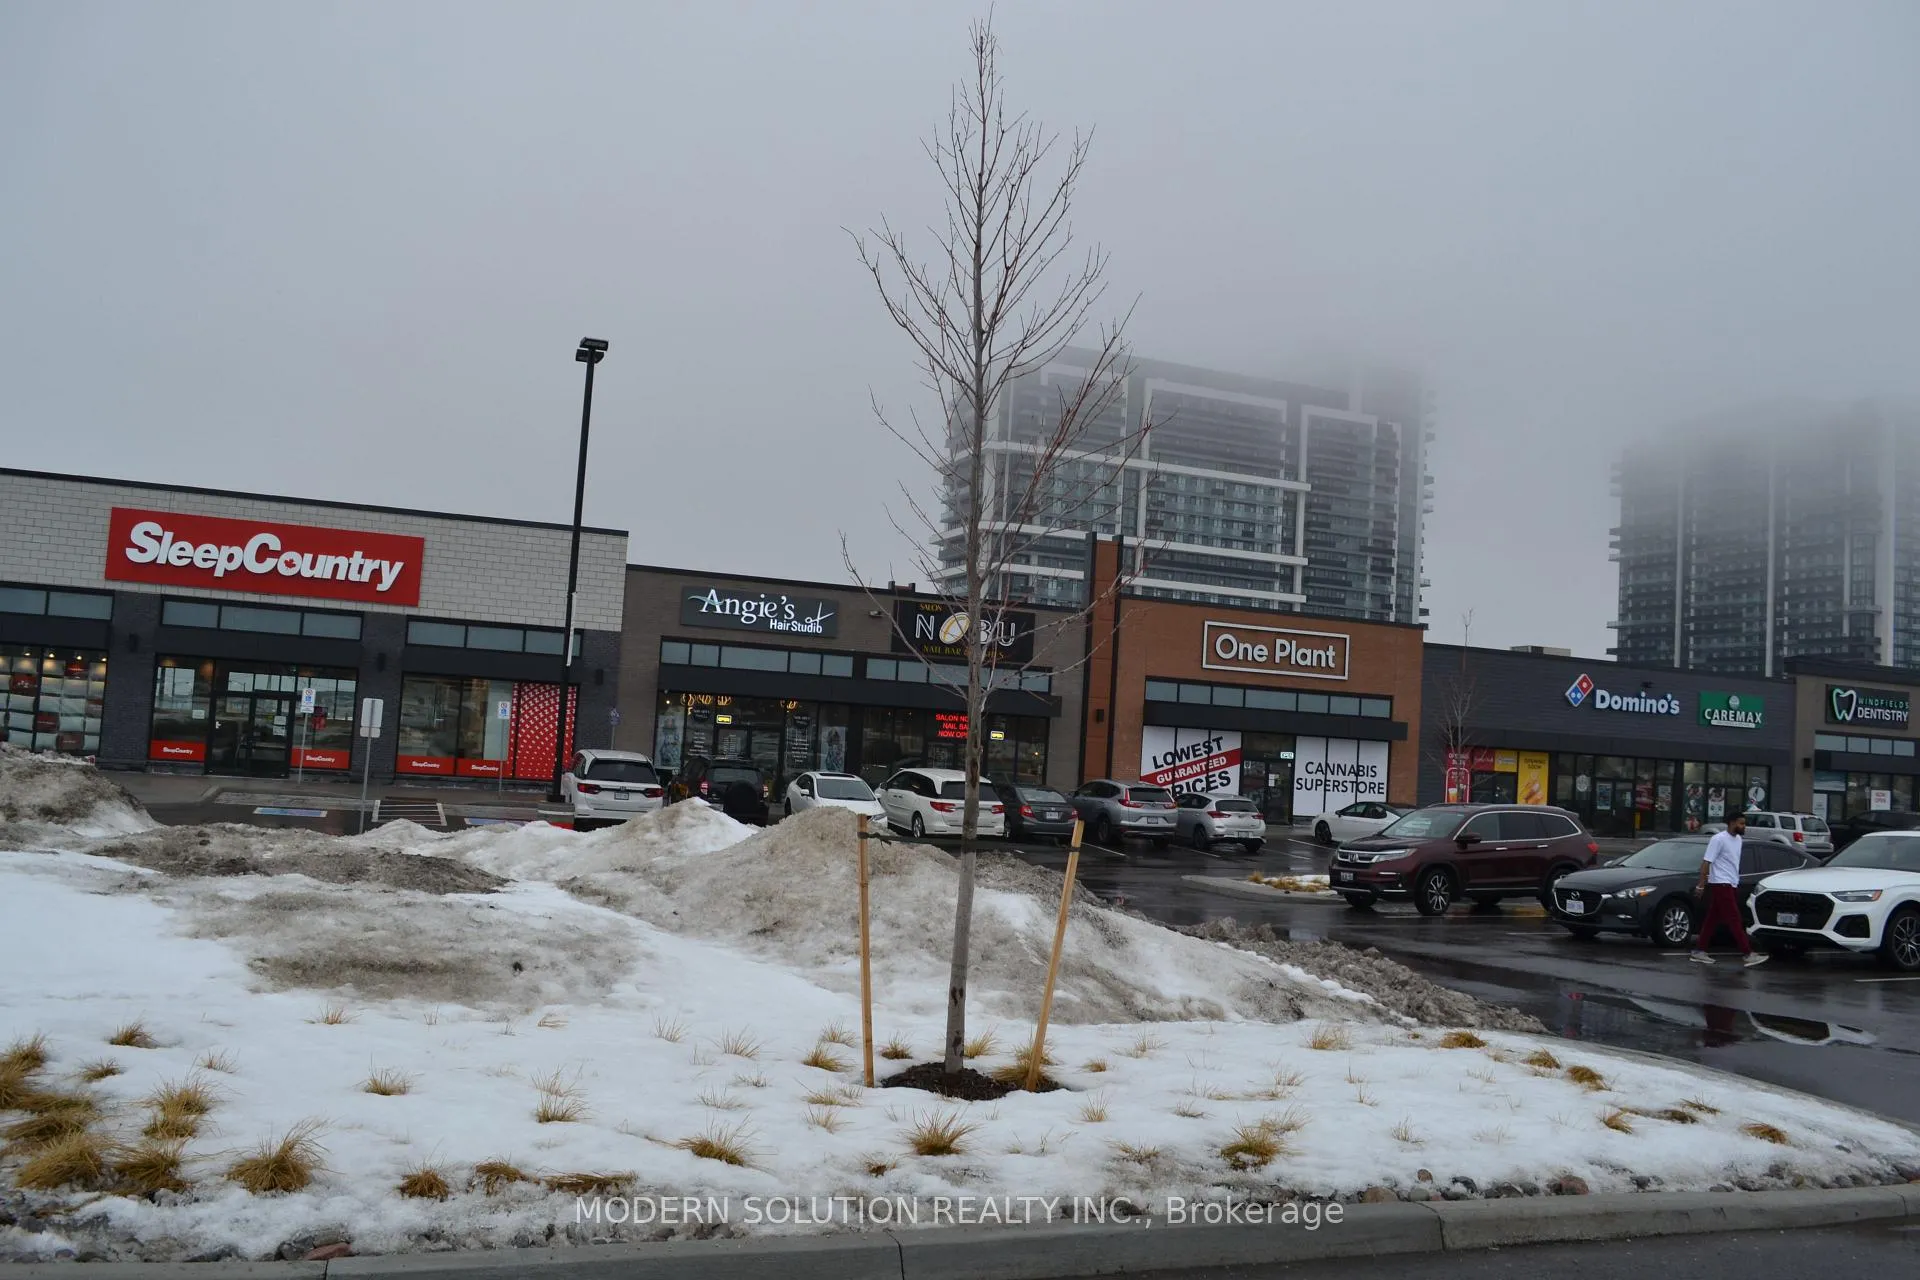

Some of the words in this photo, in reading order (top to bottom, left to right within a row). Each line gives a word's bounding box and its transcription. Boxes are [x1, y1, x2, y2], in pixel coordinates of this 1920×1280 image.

[126, 521, 404, 592] SleepCountry
[700, 589, 795, 624] Angie's
[1215, 633, 1269, 662] One
[1275, 639, 1336, 668] Plant
[1595, 689, 1681, 715] Domino's
[1858, 697, 1909, 709] WINDFIELDS
[935, 712, 959, 721] SALON
[1704, 708, 1762, 724] CAREMAX
[1857, 707, 1909, 722] DENTISTRY
[1152, 736, 1224, 769] LOWEST
[1156, 756, 1227, 784] GUARANTEED
[1304, 761, 1378, 778] CANNABIS
[1295, 778, 1385, 795] SUPERSTORE
